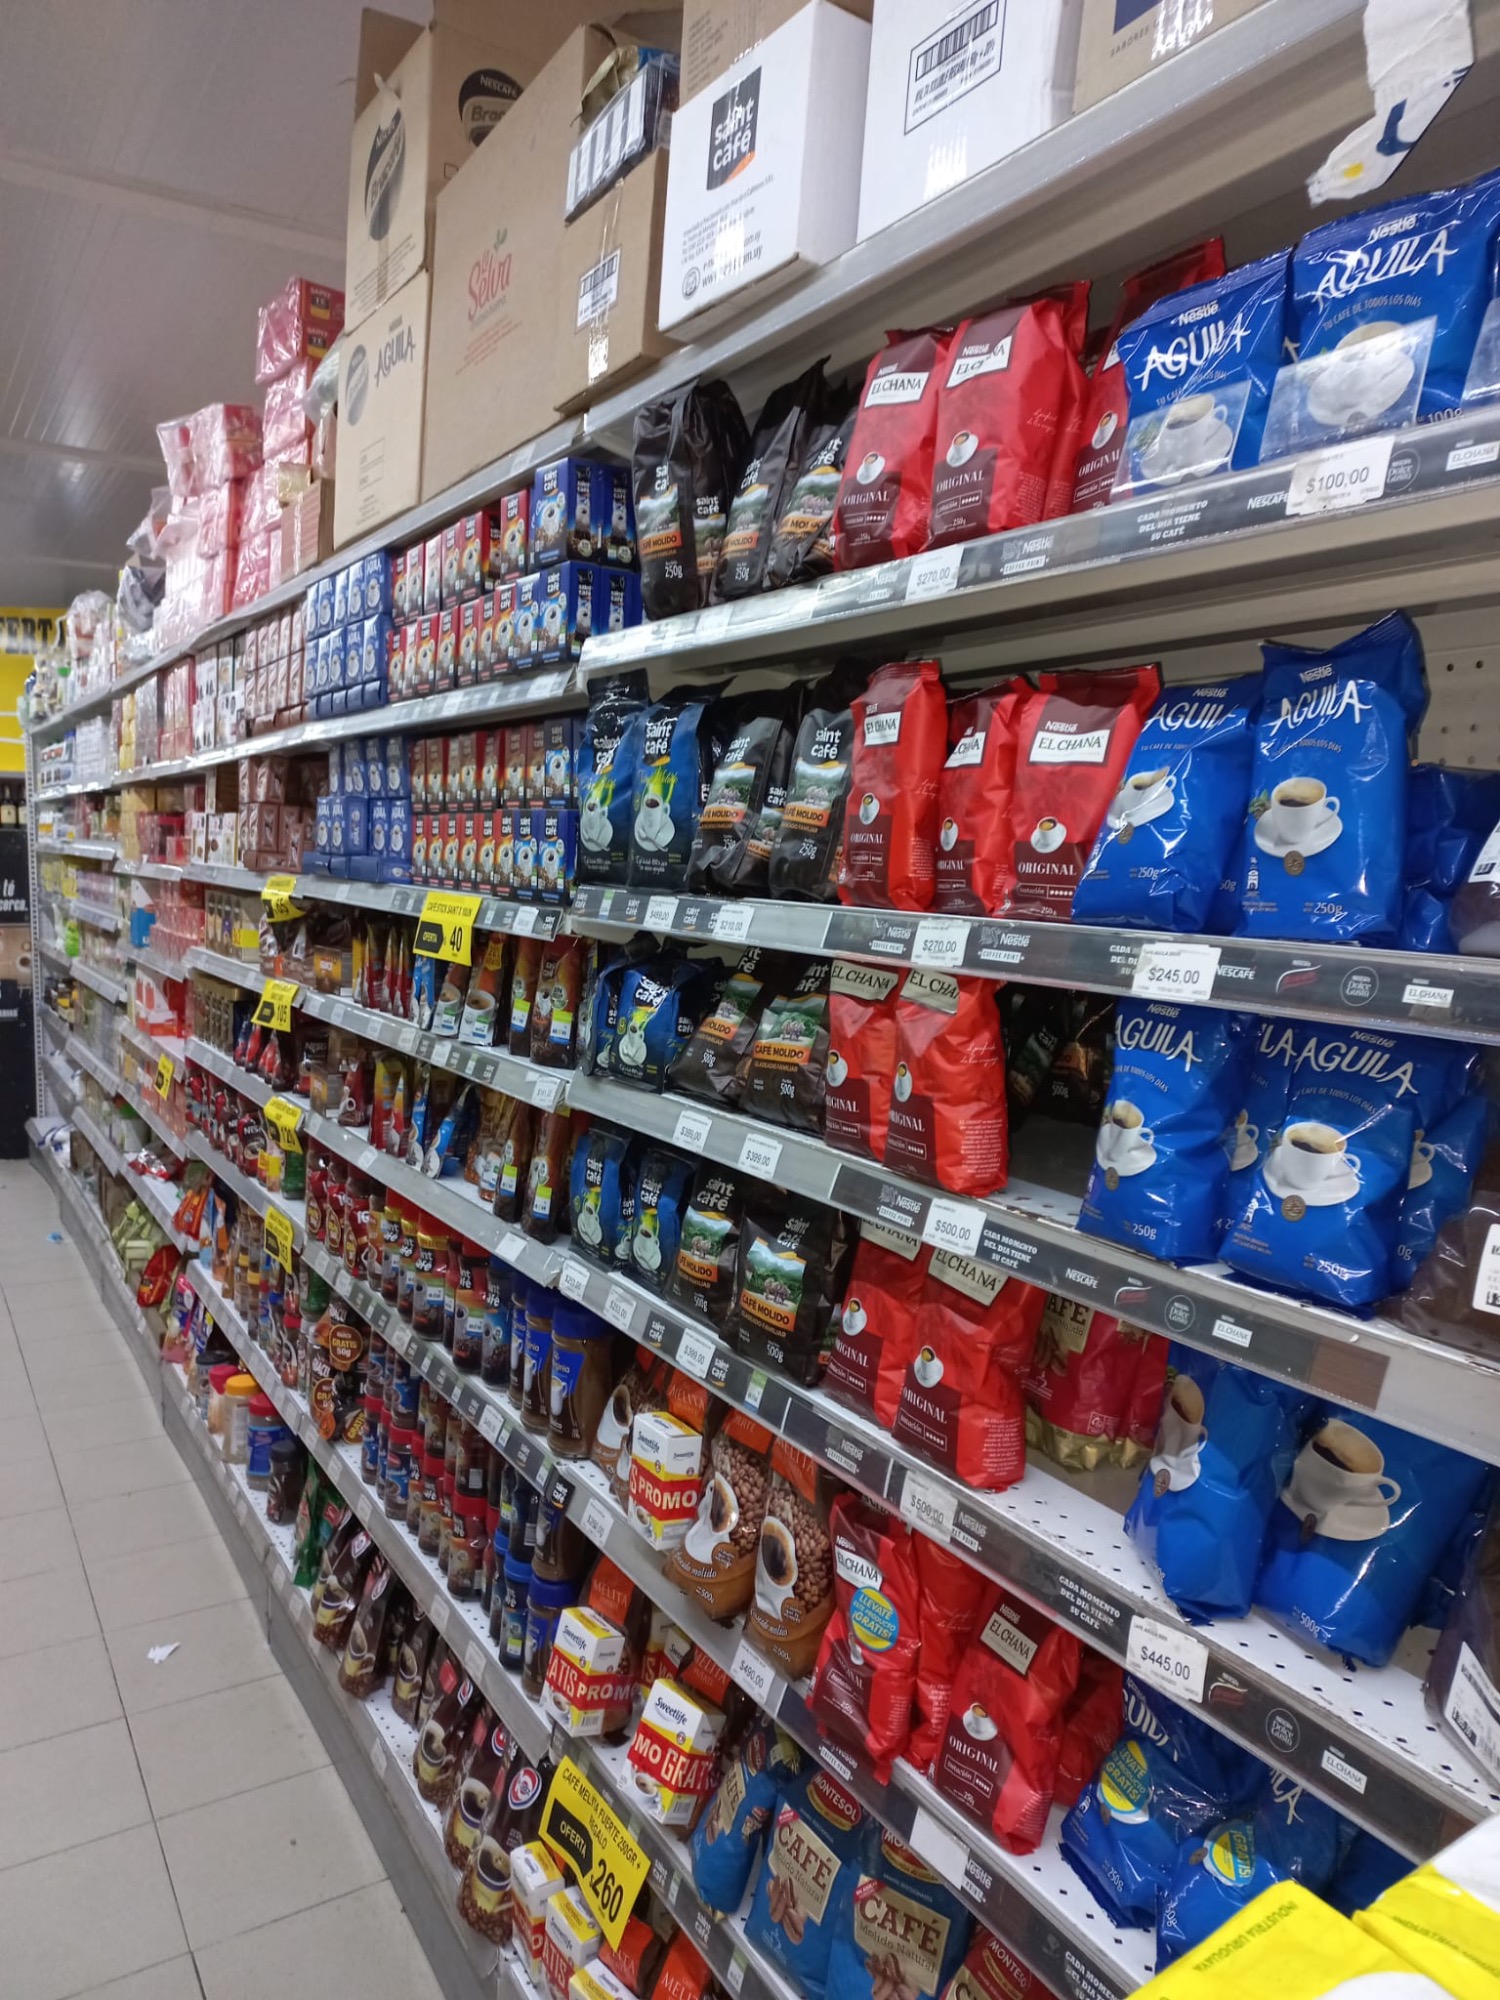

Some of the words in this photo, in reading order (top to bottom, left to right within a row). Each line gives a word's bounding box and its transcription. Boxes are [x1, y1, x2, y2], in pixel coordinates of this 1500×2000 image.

[1311, 228, 1458, 311] AGUILA
[1134, 313, 1251, 390] AGUILA
[936, 469, 985, 493] ORIGINAL
[843, 490, 890, 505] ORIGINAL
[1268, 680, 1372, 736] AGUILA
[645, 738, 668, 754] café
[811, 742, 837, 759] café
[711, 810, 739, 820] MOLIDO
[796, 810, 824, 823] MOLIDO
[1018, 862, 1077, 876] ORIGINAL
[1314, 902, 1343, 915] 250g
[772, 1046, 804, 1059] MOLIDO
[1297, 1041, 1419, 1098] AGUILA
[697, 1189, 729, 1211] café
[1132, 1222, 1157, 1240] 250g
[757, 1303, 790, 1325] MOLIDO
[638, 1481, 697, 1511] PROMO
[1140, 1645, 1191, 1680] $445,00
[655, 1697, 688, 1726] Sweetlife
[949, 1735, 998, 1774] ORIGINAL
[561, 1767, 579, 1792] CAFÉ
[599, 1811, 620, 1843] FUERTE
[813, 1774, 858, 1822] MONTESOL
[559, 1819, 587, 1859] OFERTA
[589, 1814, 607, 1850] REGALO
[777, 1823, 833, 1892] CAFÉ
[858, 1894, 941, 1957] CAFÉ
[859, 1922, 894, 1949] Molido
[896, 1942, 937, 1974] Natural
